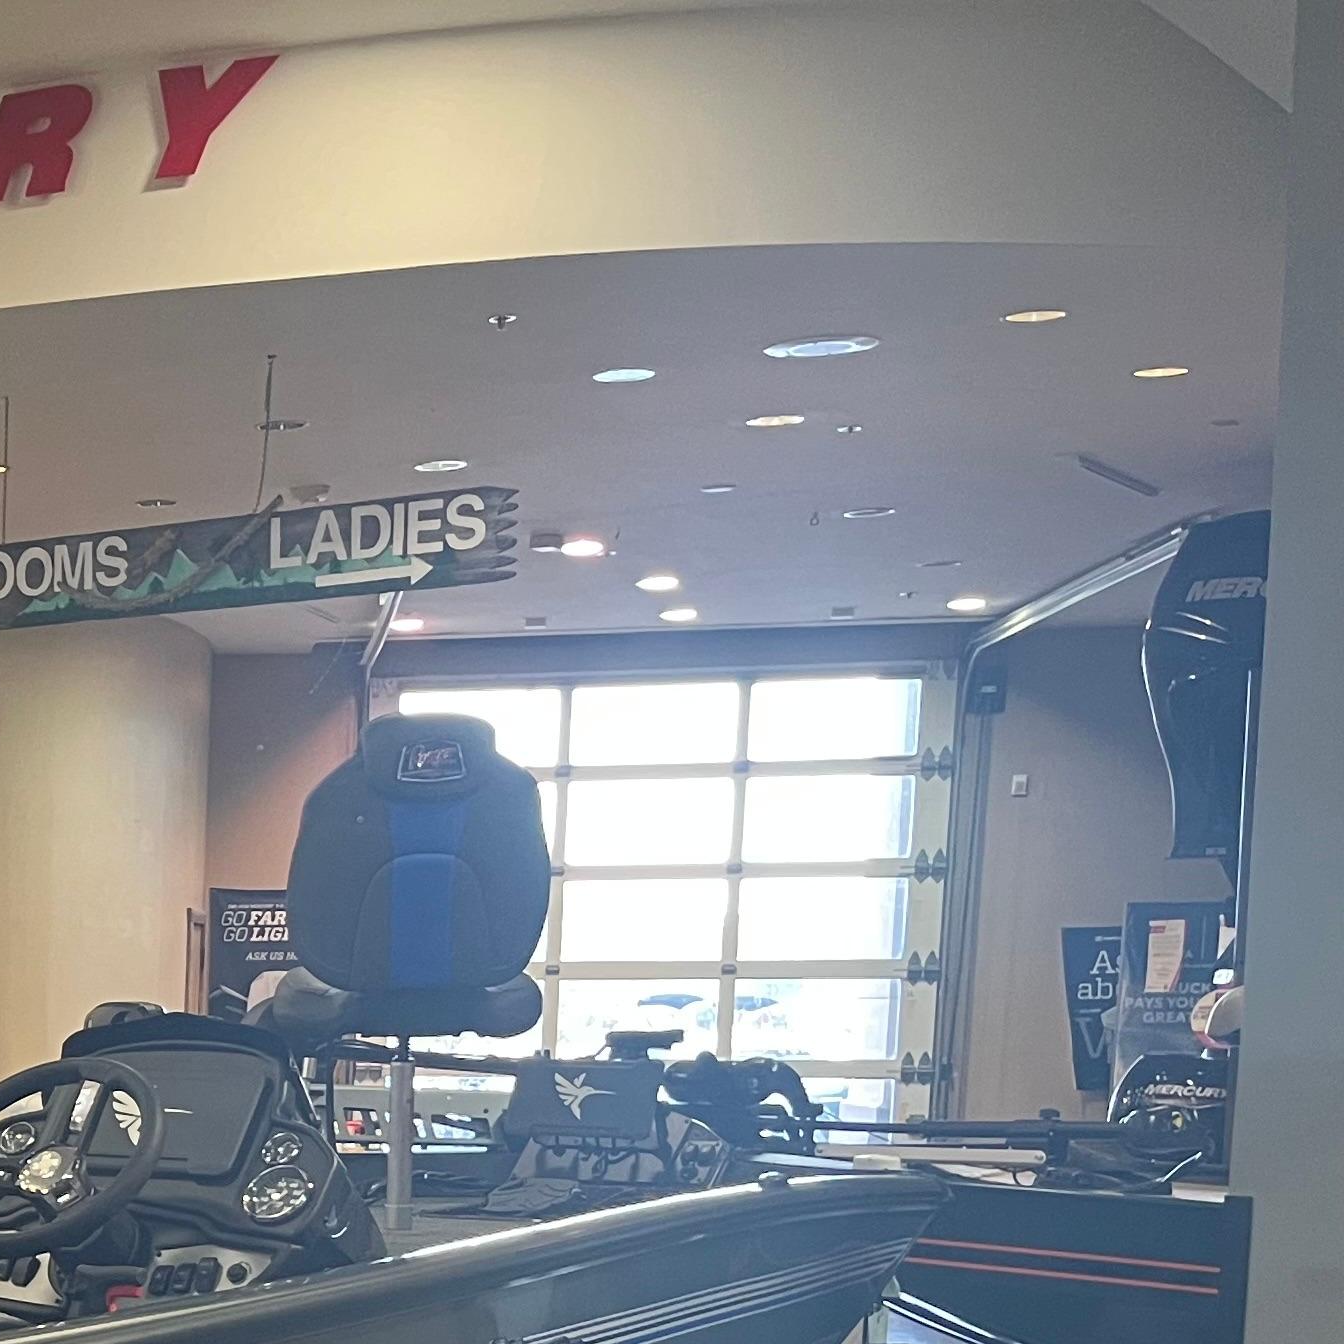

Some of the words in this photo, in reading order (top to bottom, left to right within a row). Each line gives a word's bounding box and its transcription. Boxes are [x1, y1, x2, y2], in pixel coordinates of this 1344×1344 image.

[269, 493, 487, 569] LADIES
[221, 910, 247, 927] GO
[223, 926, 249, 942] GO
[245, 951, 268, 961] ASK
